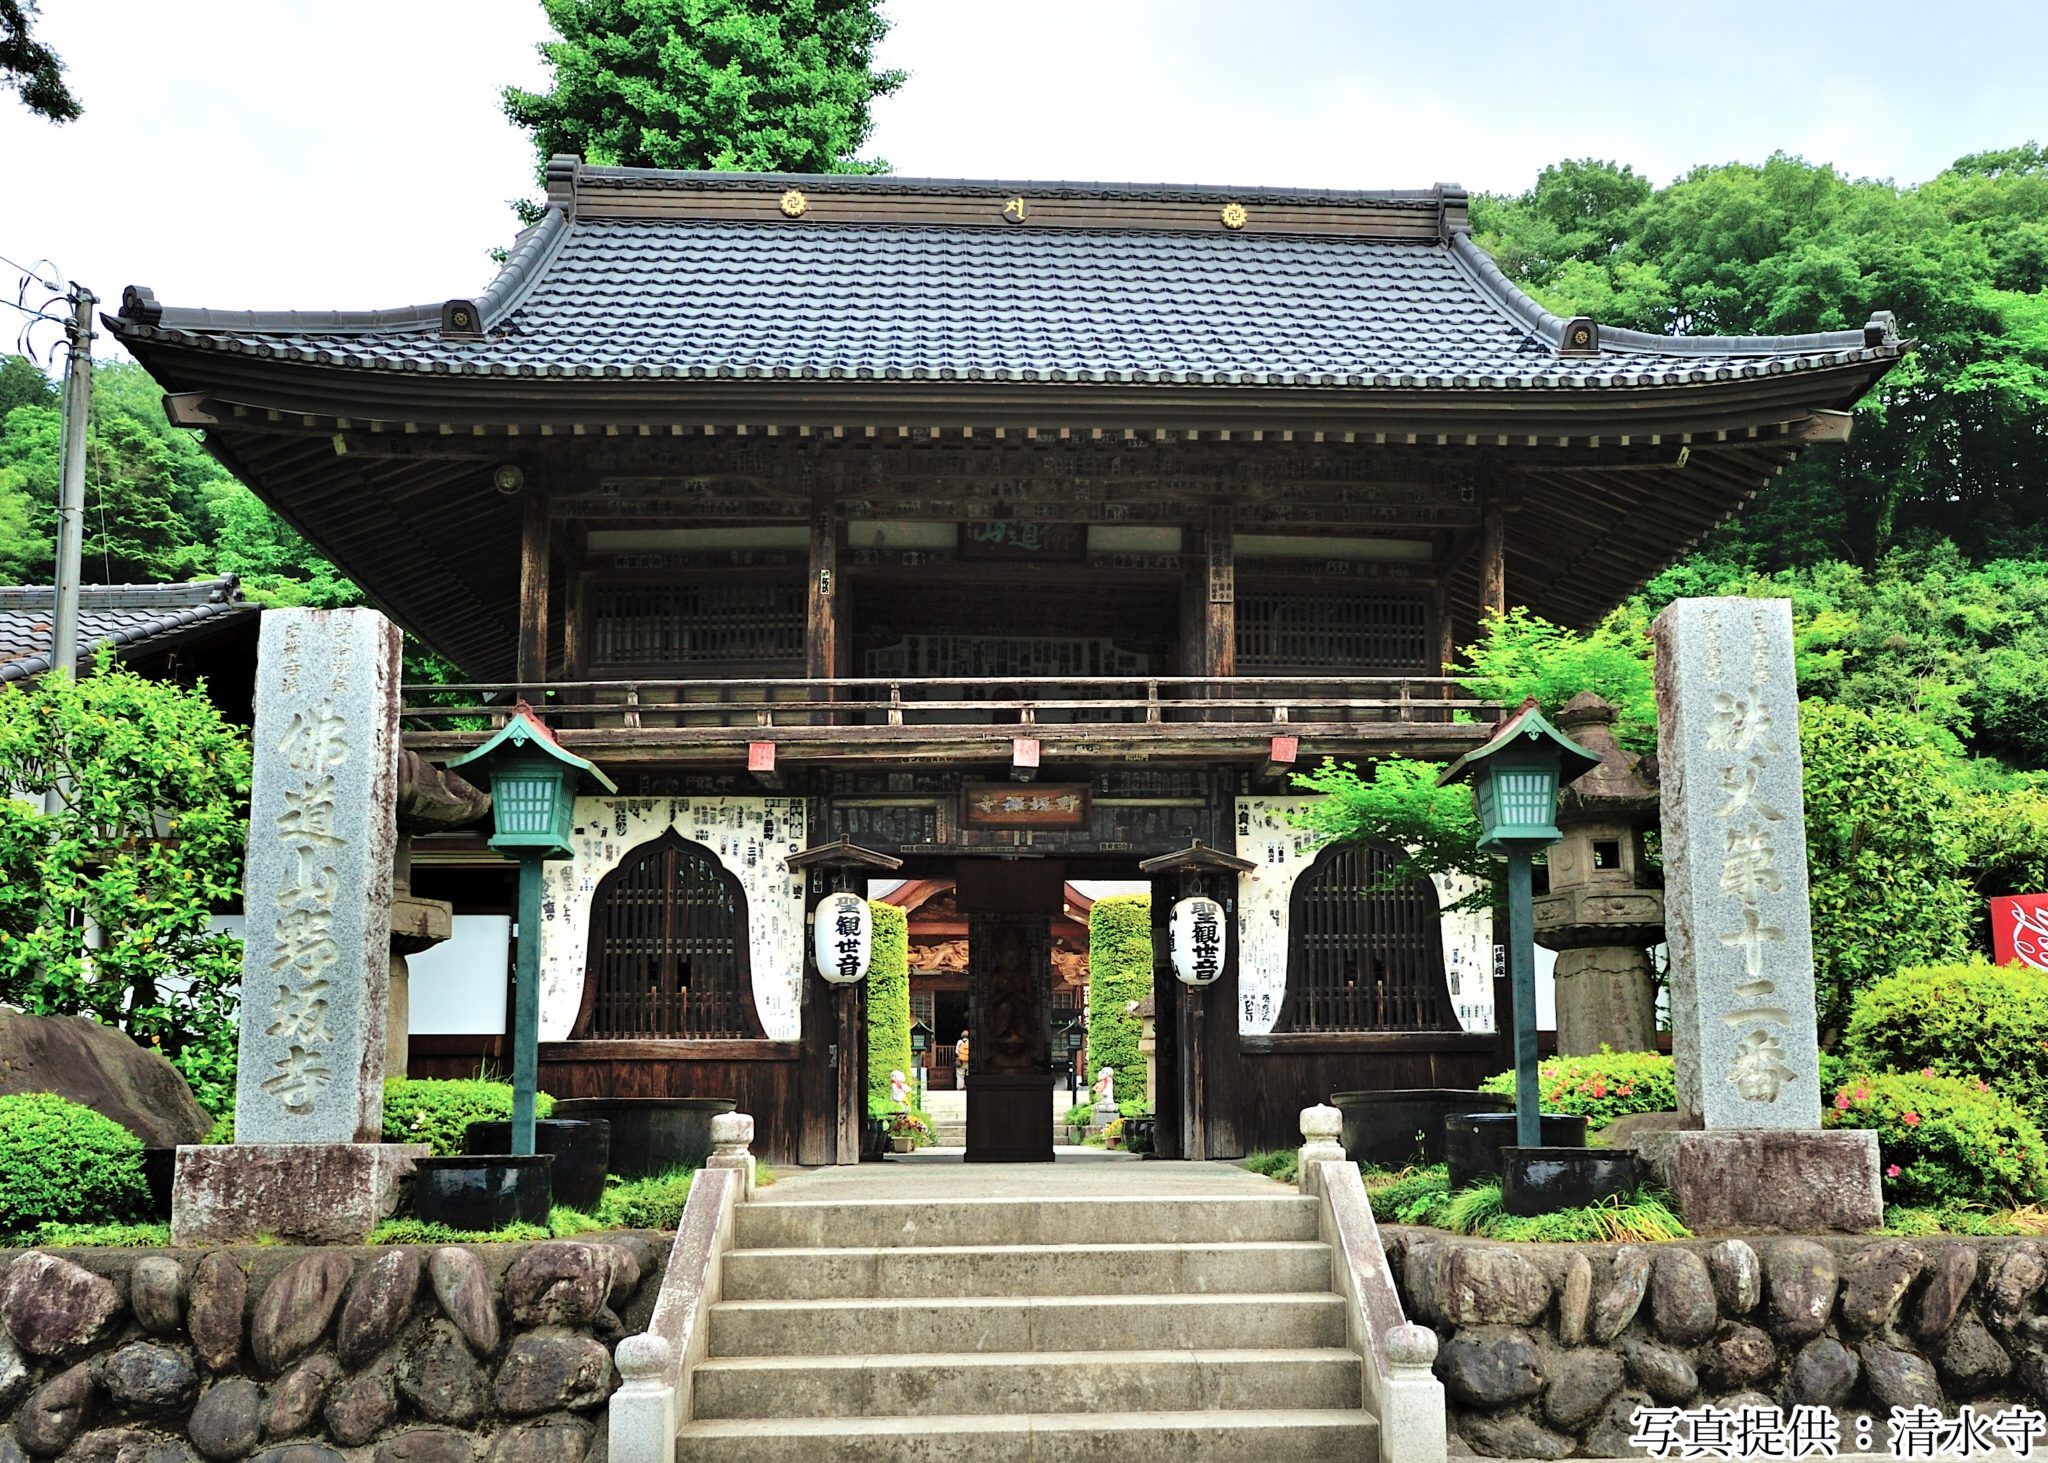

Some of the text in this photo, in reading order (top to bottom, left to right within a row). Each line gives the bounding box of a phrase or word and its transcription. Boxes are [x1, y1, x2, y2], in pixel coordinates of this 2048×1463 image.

[1706, 685, 1798, 1102] 秩父第十二番
